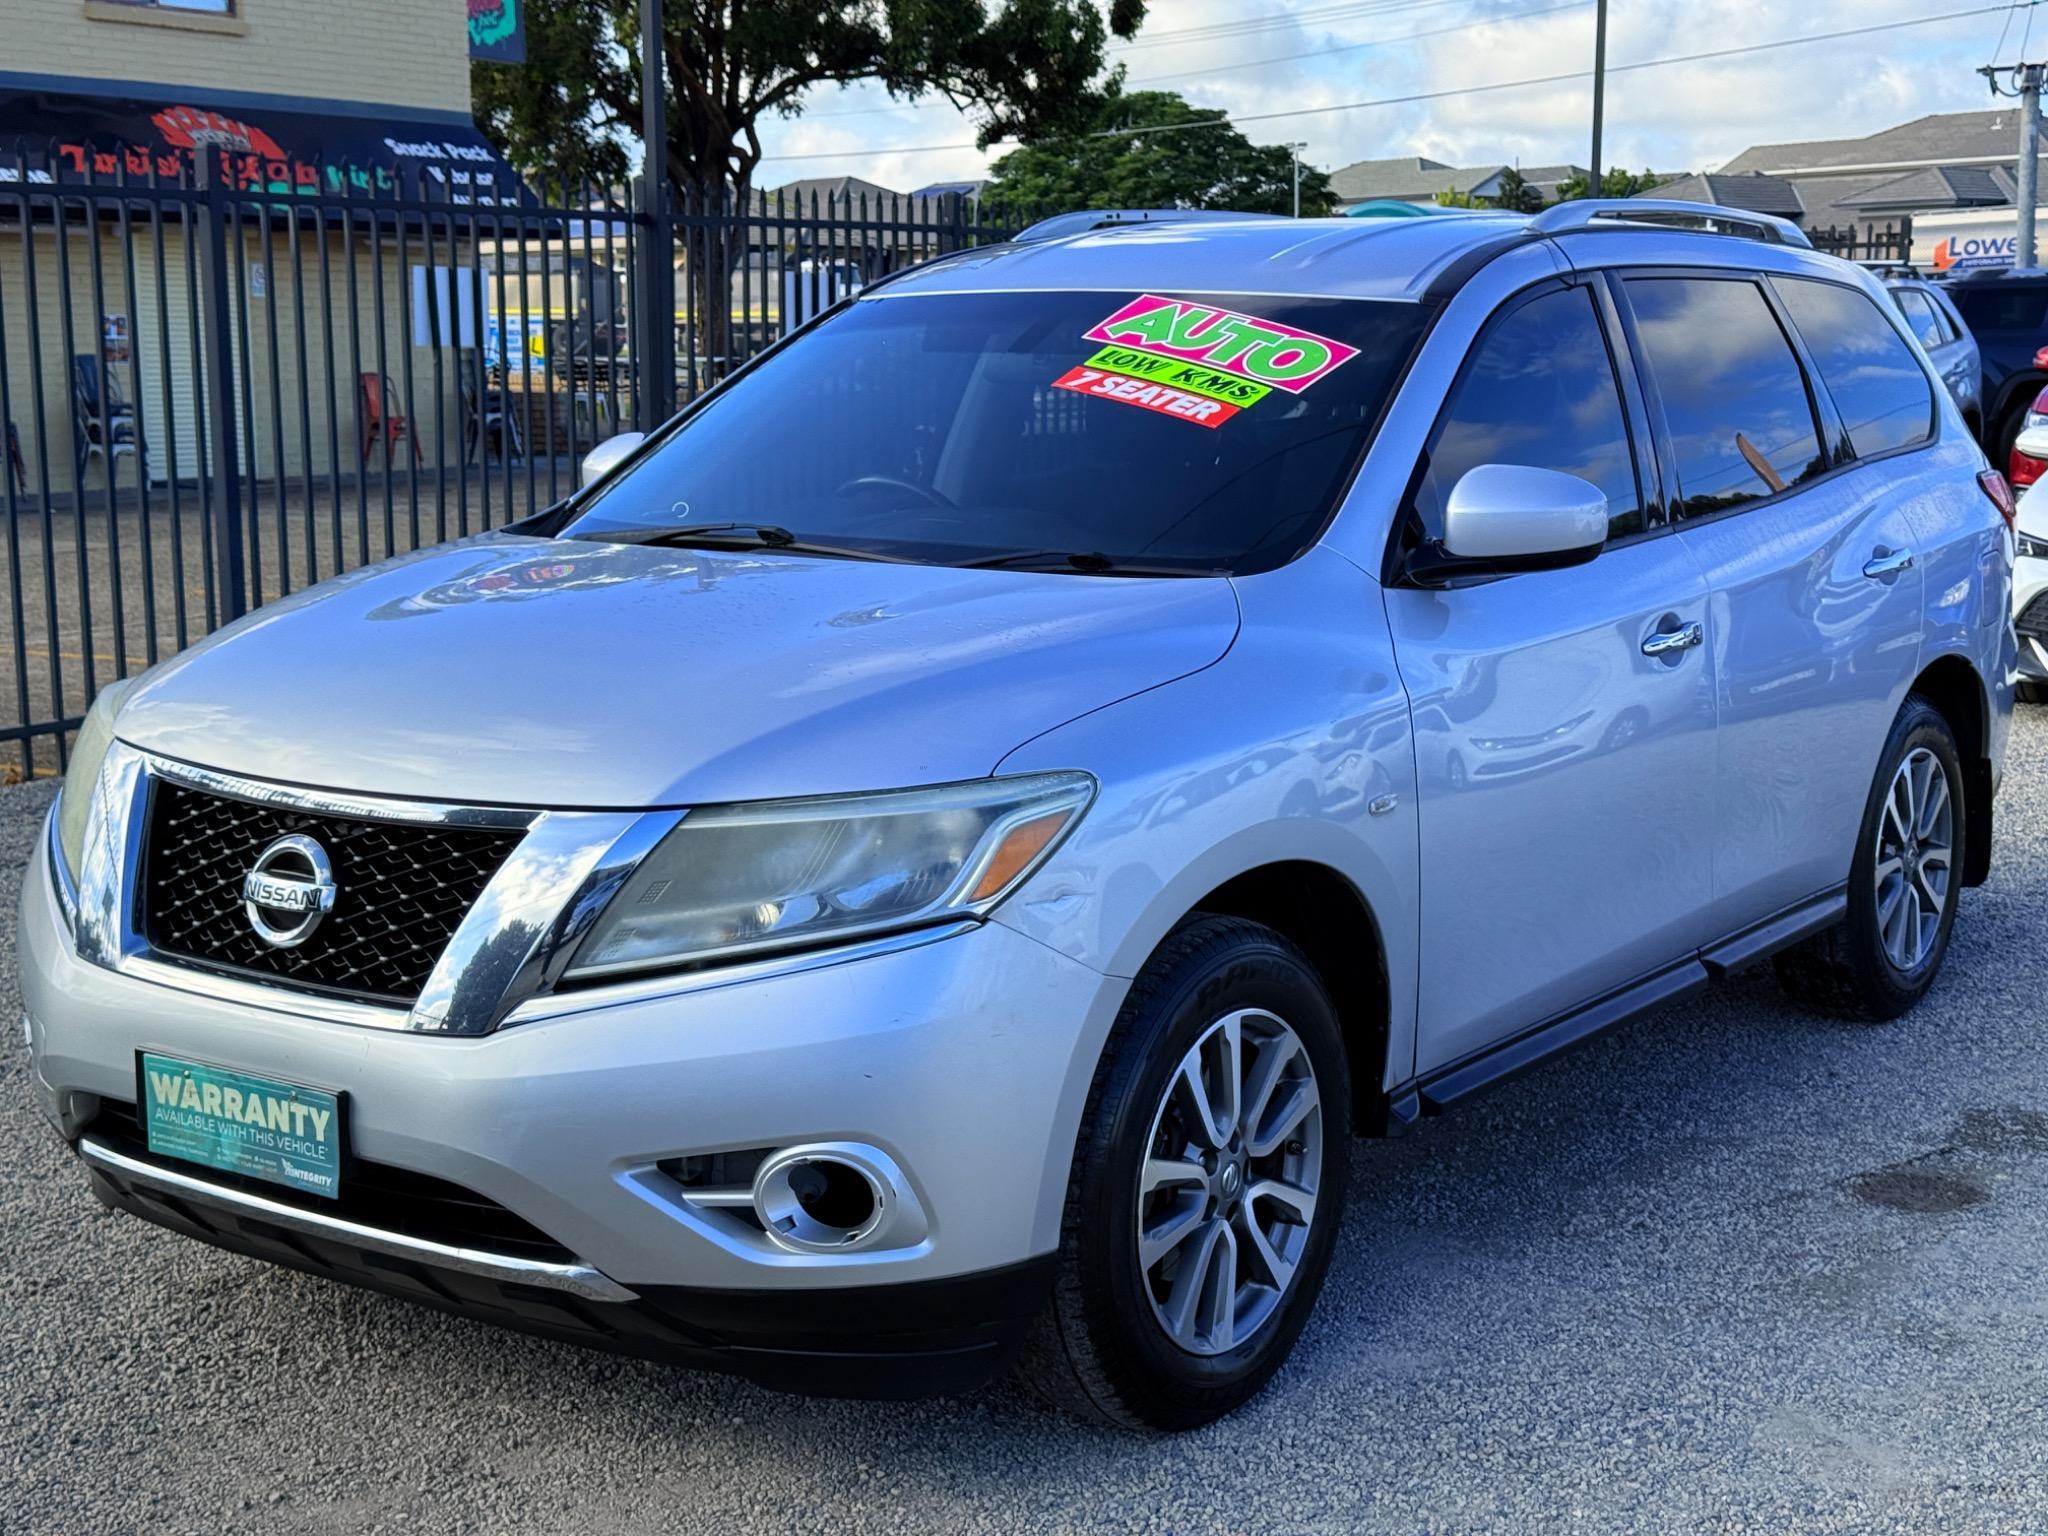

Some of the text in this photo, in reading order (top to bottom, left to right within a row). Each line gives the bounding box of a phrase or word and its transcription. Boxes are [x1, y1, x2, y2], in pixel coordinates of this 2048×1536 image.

[384, 137, 496, 162] Snack Pack
[1104, 304, 1332, 381] AUTO
[1064, 371, 1222, 421] 7 SEATER
[1095, 348, 1261, 401] LOW KMS
[246, 880, 322, 909] NISSAN
[149, 1071, 330, 1142] WARRANTY
[155, 1107, 216, 1133] AVAILABLE
[217, 1121, 248, 1141] WITH
[249, 1129, 275, 1148] THIS
